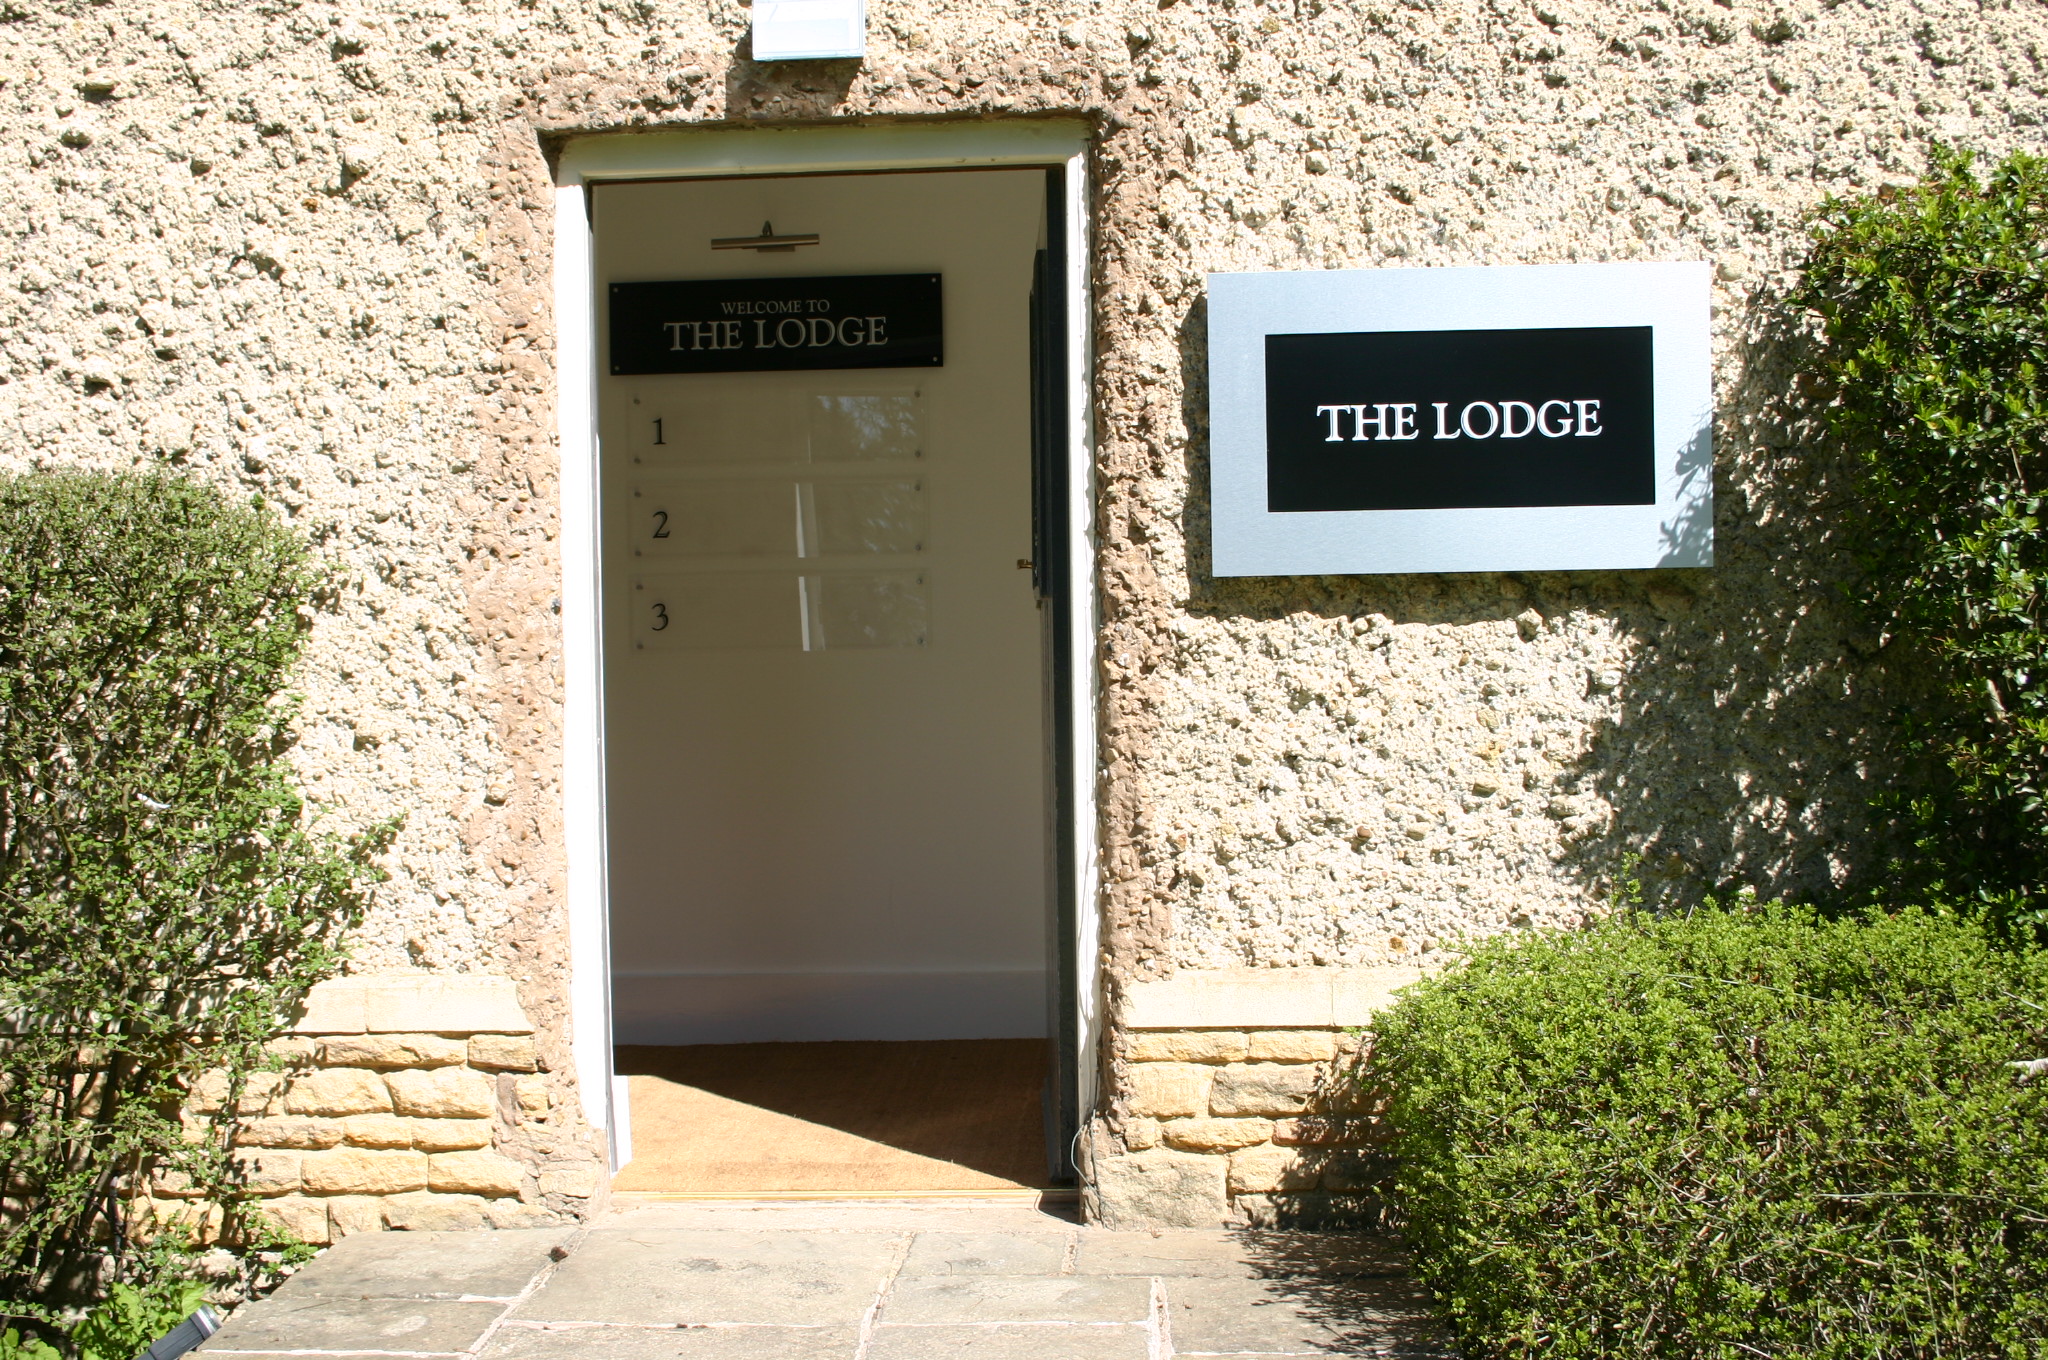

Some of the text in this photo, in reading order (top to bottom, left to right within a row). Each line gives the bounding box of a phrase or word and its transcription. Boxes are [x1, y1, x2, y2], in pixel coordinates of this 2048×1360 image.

[721, 300, 830, 314] WELCOME TO
[664, 317, 888, 350] THE LODGE
[652, 418, 666, 445] 1
[1316, 400, 1602, 441] THE LODGE
[652, 511, 670, 538] 2
[651, 603, 669, 631] 3
